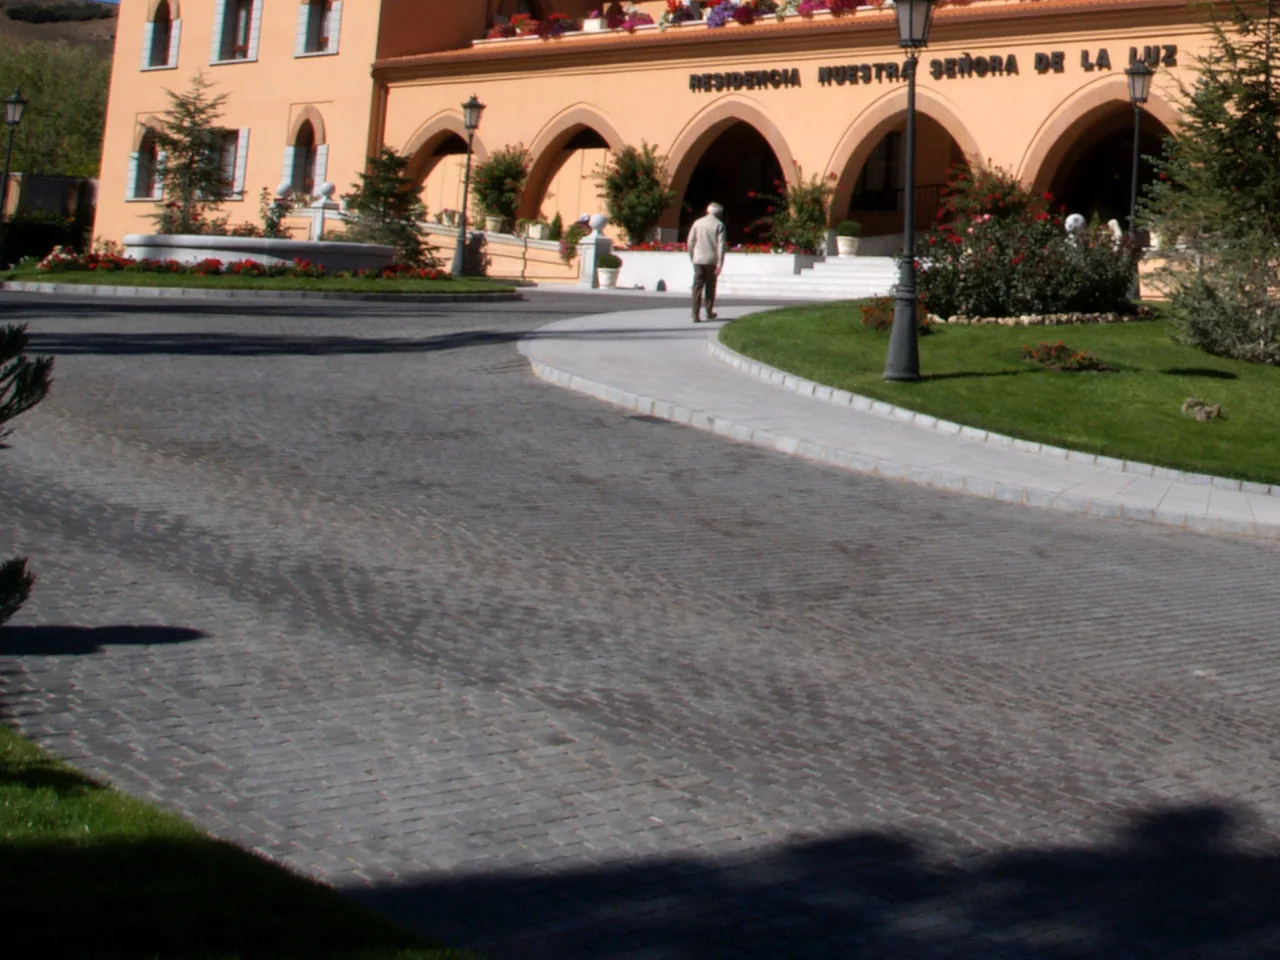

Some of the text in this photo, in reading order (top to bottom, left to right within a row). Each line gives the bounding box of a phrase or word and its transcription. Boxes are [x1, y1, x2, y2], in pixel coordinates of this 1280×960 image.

[689, 68, 801, 93] RESIDENCIA
[929, 52, 1018, 80] SEÑORA
[1034, 51, 1064, 74] DE
[1081, 48, 1111, 71] LA
[1129, 44, 1178, 69] LUZ
